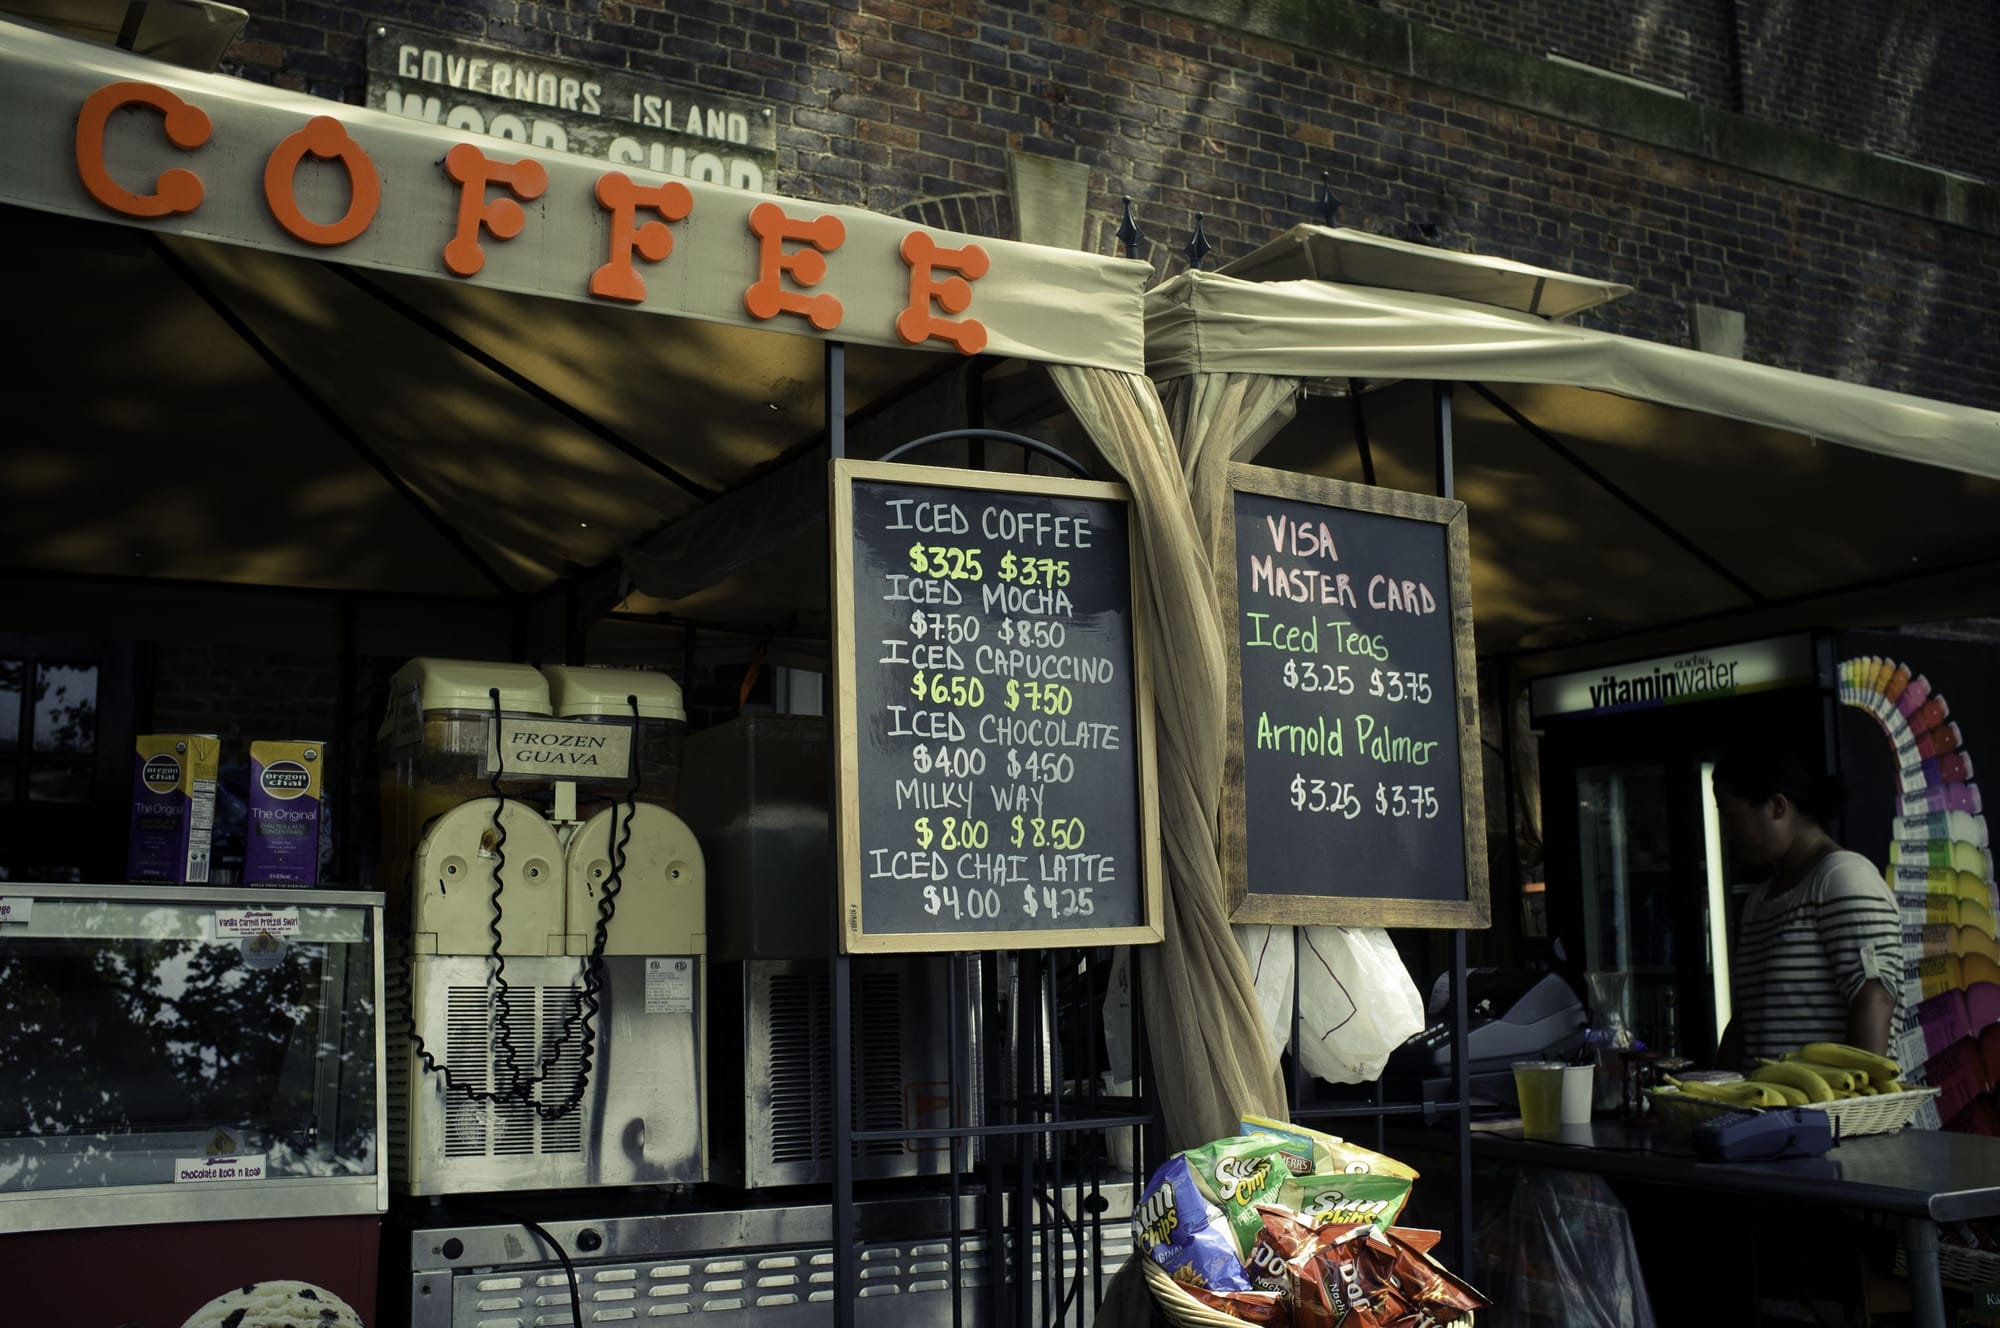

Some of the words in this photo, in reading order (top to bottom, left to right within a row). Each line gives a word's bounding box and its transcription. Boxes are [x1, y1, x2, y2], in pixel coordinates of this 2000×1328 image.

[399, 45, 600, 115] GOVERNORS
[633, 93, 748, 145] ISLAND
[76, 81, 990, 355] COFFEE
[885, 499, 969, 534] ICED
[982, 506, 1092, 548] COFFEE
[1267, 514, 1339, 561] VISA
[998, 550, 1071, 588] $3.75
[1251, 555, 1356, 608] MASTER
[1368, 574, 1436, 615] CARD
[883, 574, 962, 605] ICED
[982, 583, 1073, 617] MOCHA
[909, 609, 980, 644] $7.50
[998, 617, 1065, 648] $8.50
[1246, 612, 1318, 653] Iced
[1327, 621, 1389, 661] Teas
[879, 639, 965, 671] ICED
[975, 645, 1113, 684] CAPUCCINO
[1283, 659, 1355, 695] $3.25
[1369, 668, 1432, 703] $3.75
[910, 670, 985, 707] $6.50
[1004, 679, 1073, 715] $7.50
[1589, 659, 1738, 708] vitaminwater
[512, 732, 607, 748] FROZEN
[887, 705, 966, 741] ICED
[979, 714, 1119, 749] CHOCOLATE
[1257, 712, 1343, 756] Arnold
[1355, 714, 1438, 765] Palmer
[147, 766, 179, 775] oregon
[149, 772, 176, 780] chai
[265, 772, 306, 781] oregon
[516, 750, 598, 765] GUAVA
[913, 743, 986, 778] $4.00
[1007, 748, 1074, 783] $4.50
[269, 779, 302, 787] chai
[896, 779, 973, 819] MILKY
[991, 783, 1045, 817] WAY
[1290, 773, 1361, 819] $3.25
[1375, 783, 1438, 818] $3.75
[135, 803, 152, 814] The
[251, 807, 273, 819] The
[274, 808, 317, 822] Original
[869, 849, 948, 880] ICED
[957, 853, 1028, 887] CHAI
[1040, 853, 1115, 882] LATTE
[923, 885, 1000, 920] $4.00
[1023, 884, 1094, 919] $4.25
[1304, 1191, 1389, 1216] Sun
[1141, 1209, 1178, 1255] Chips
[1255, 1275, 1287, 1296] Nacho
